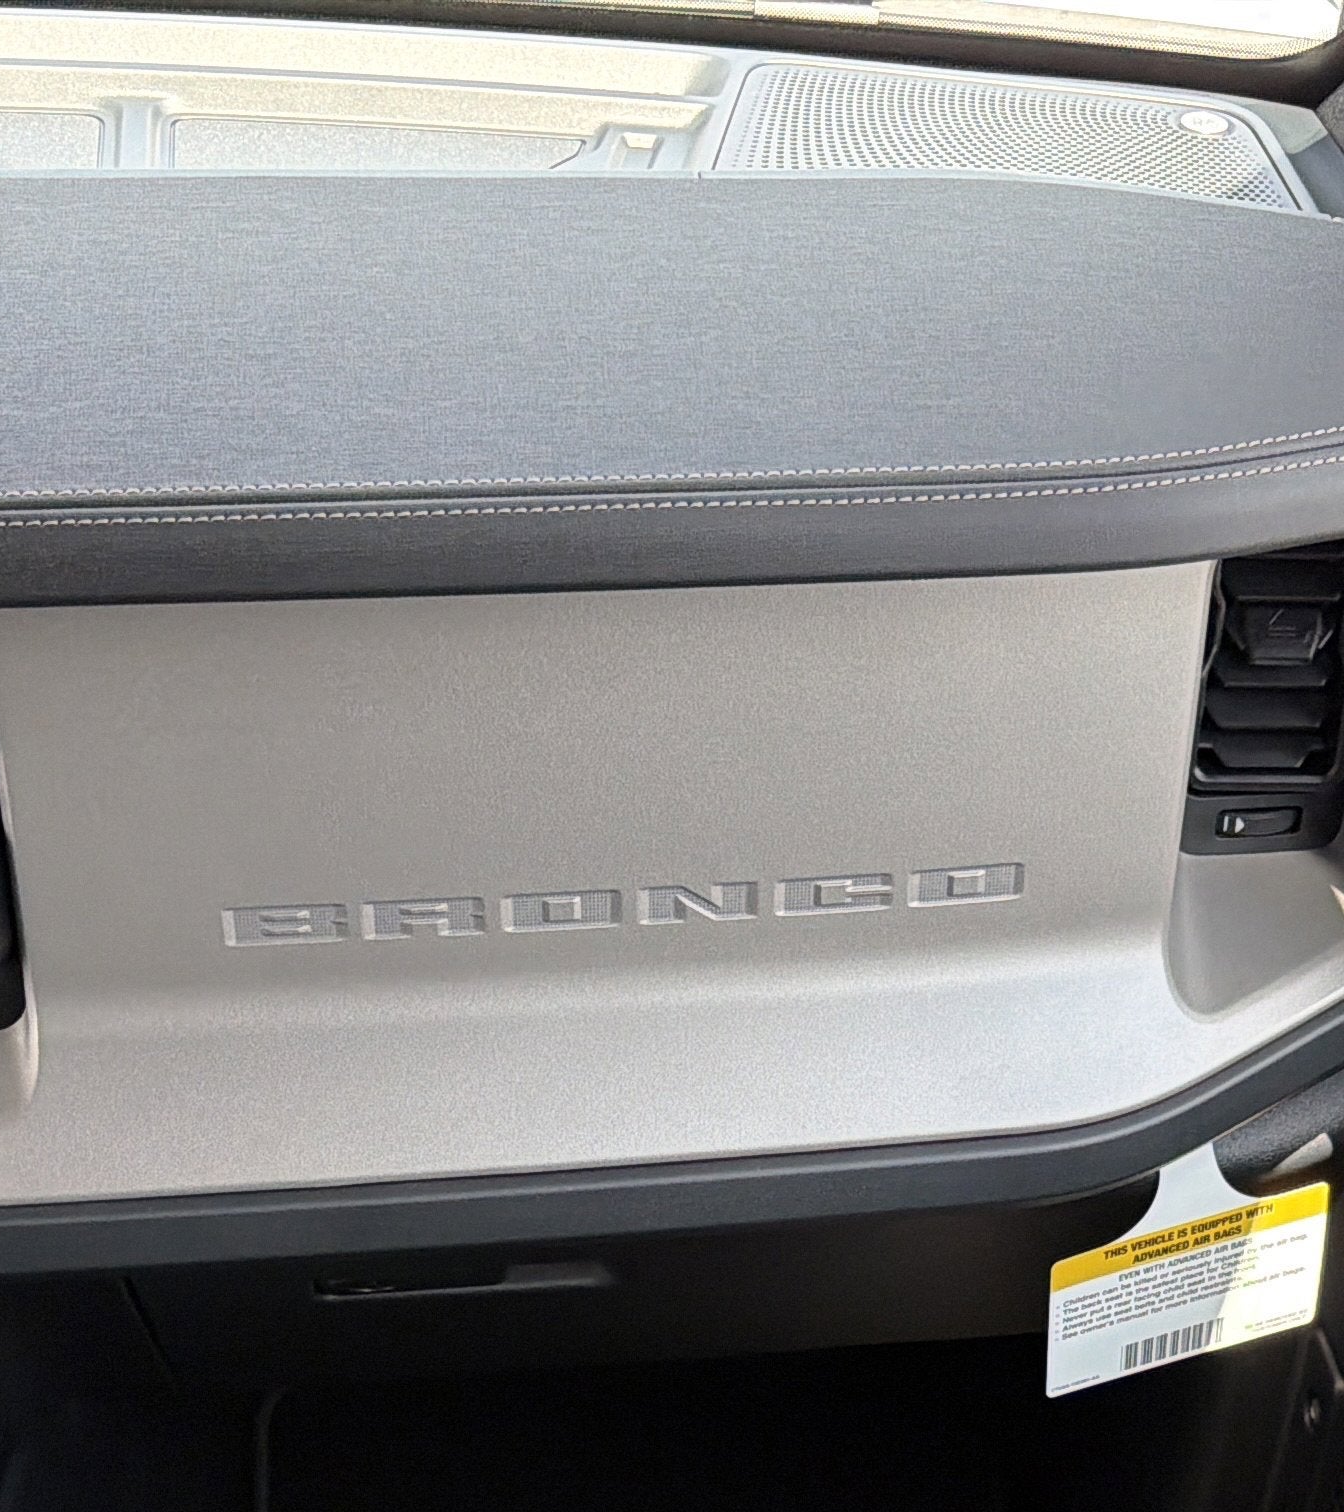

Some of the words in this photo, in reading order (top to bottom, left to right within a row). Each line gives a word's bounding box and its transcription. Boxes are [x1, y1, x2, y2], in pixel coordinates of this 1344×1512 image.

[220, 861, 1026, 949] BRONCO
[1103, 1245, 1129, 1260] THIS
[1130, 1232, 1175, 1253] VEHICLE
[1177, 1228, 1188, 1240] IS
[1190, 1212, 1243, 1235] EQUIPPED
[1245, 1203, 1274, 1220] WITH
[1132, 1240, 1190, 1264] ADVANCED
[1192, 1234, 1211, 1248] AIR
[1213, 1225, 1242, 1241] BAGS
[1118, 1270, 1141, 1282] EVEN
[1143, 1262, 1165, 1275] WITH
[1167, 1250, 1212, 1268] ADVANCED
[1214, 1244, 1229, 1256] AIR
